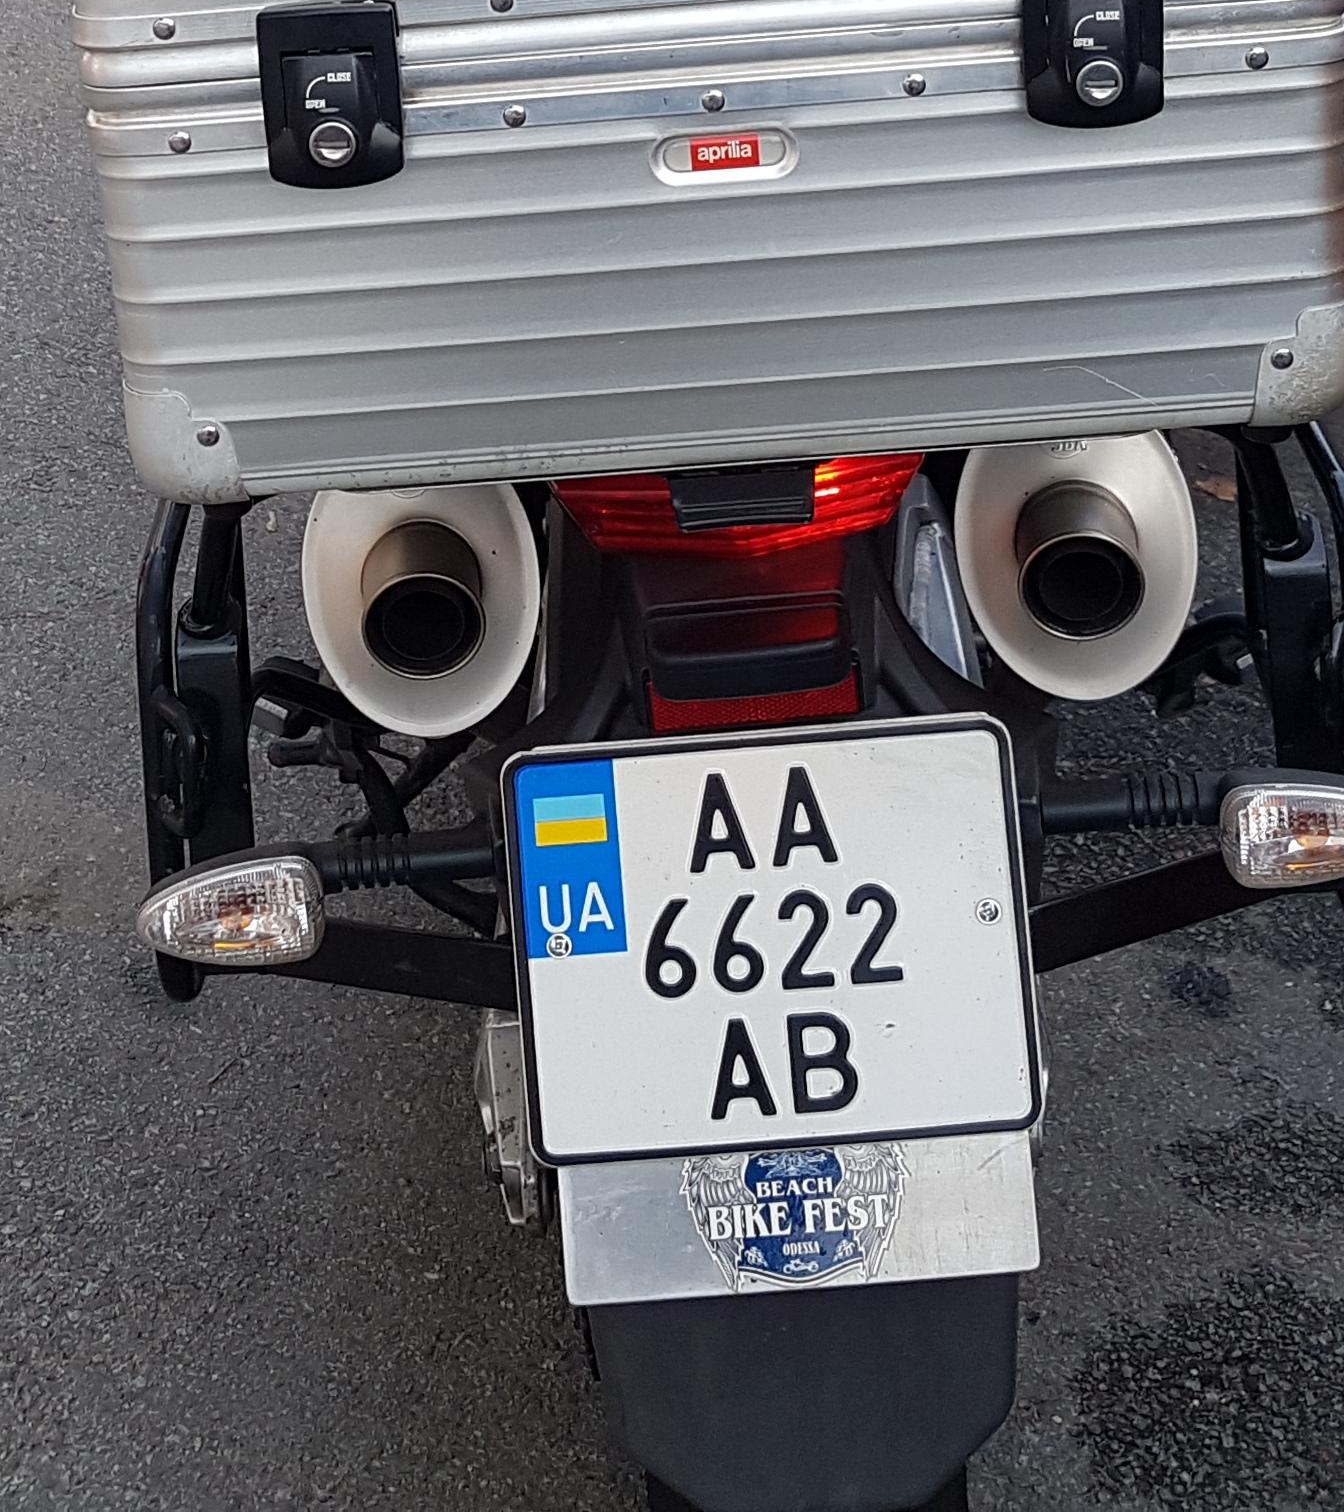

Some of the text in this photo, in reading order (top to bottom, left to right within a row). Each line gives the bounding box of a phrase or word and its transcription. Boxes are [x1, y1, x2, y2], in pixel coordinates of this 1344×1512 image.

[697, 140, 753, 164] aprilia
[689, 766, 839, 874] AA
[539, 881, 615, 933] UA
[644, 884, 904, 999] 6622
[710, 1011, 859, 1121] AB
[756, 1177, 833, 1198] BEACH
[708, 1193, 888, 1241] BIKE FEST
[782, 1241, 820, 1257] ODESSA
